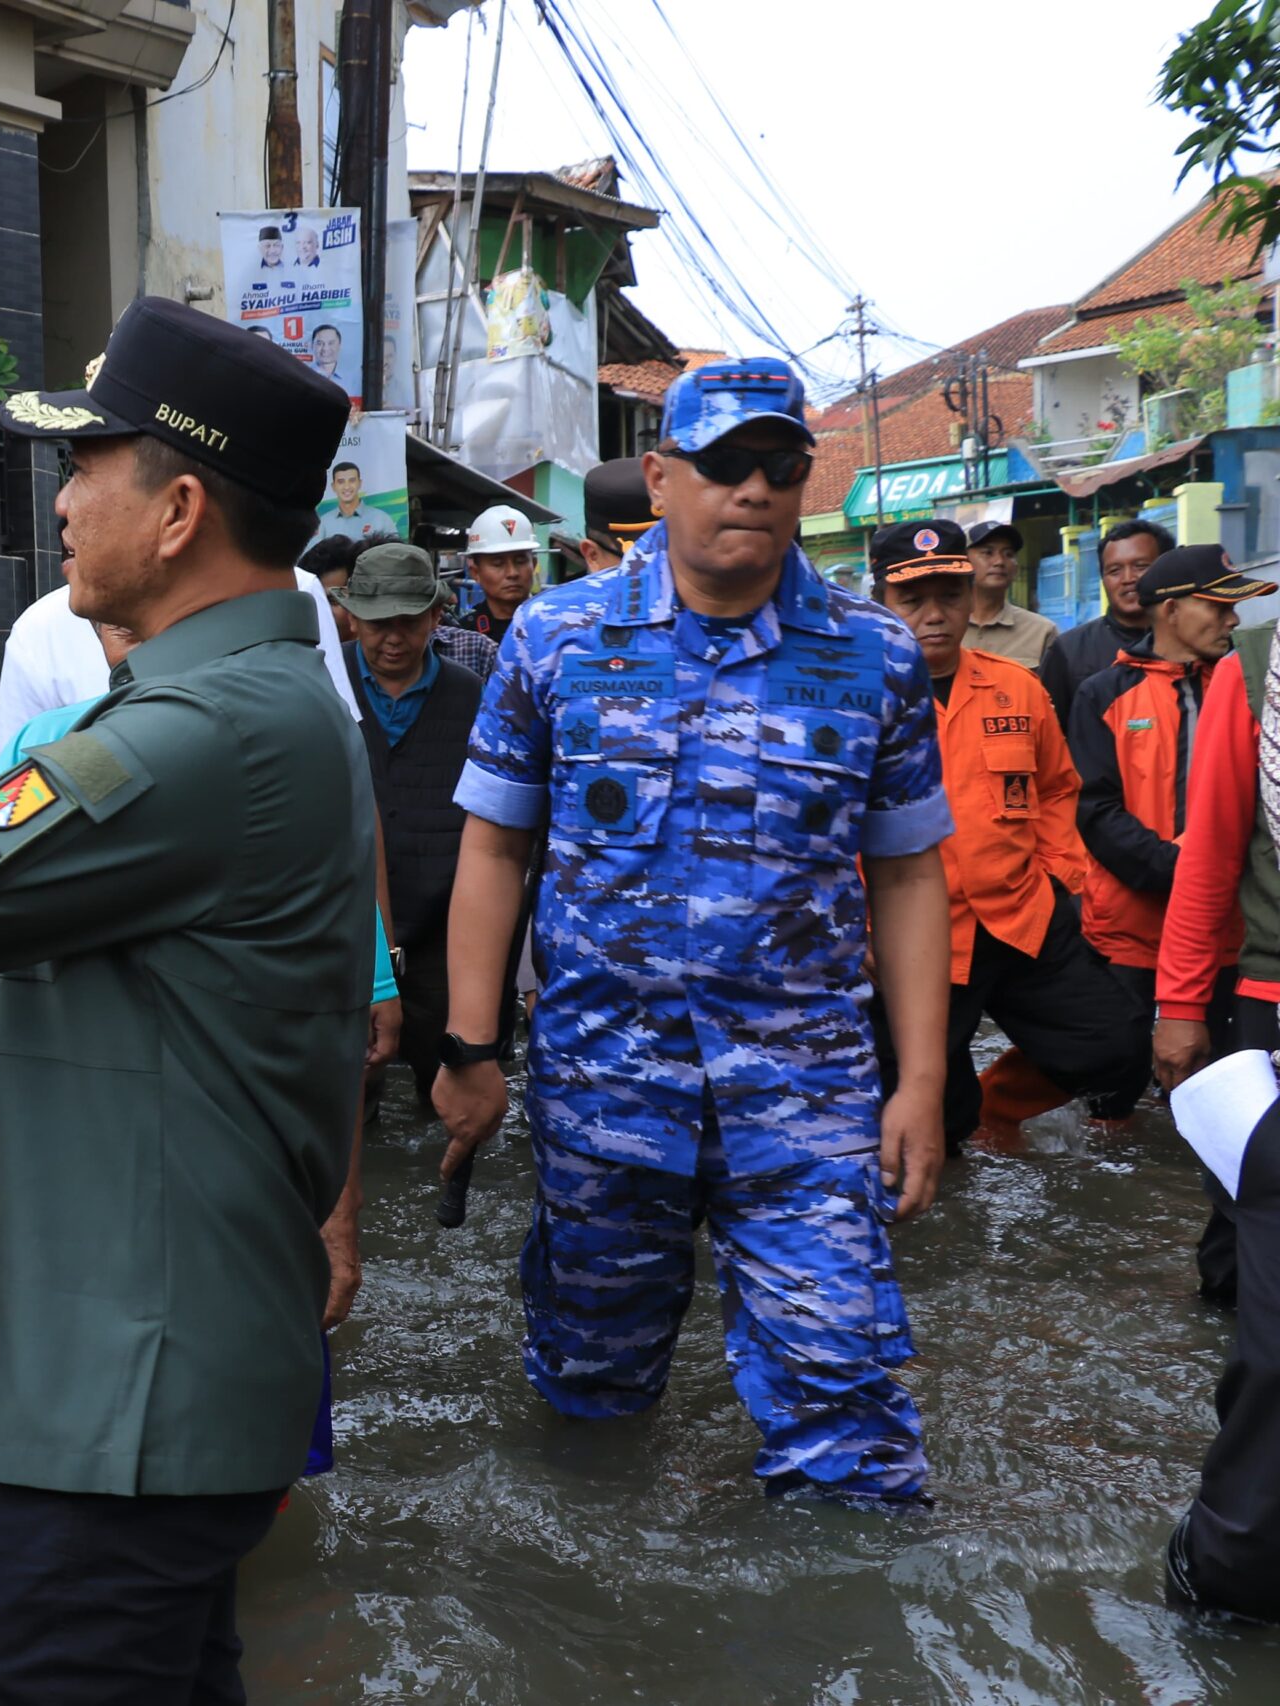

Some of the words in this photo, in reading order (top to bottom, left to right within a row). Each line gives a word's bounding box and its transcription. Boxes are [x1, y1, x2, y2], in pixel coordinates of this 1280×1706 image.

[282, 212, 299, 233] 3
[326, 214, 353, 231] JABAR
[325, 227, 353, 248] ASIH
[240, 293, 297, 311] SYAIKHU
[241, 290, 270, 300] Ahmad
[301, 287, 352, 302] HABIBIE
[287, 319, 297, 337] 1
[155, 403, 228, 451] BUPATI
[570, 680, 663, 694] KUSMAYADI
[784, 686, 825, 703] TNI
[838, 691, 872, 709] AU
[985, 716, 1027, 734] BPBD
